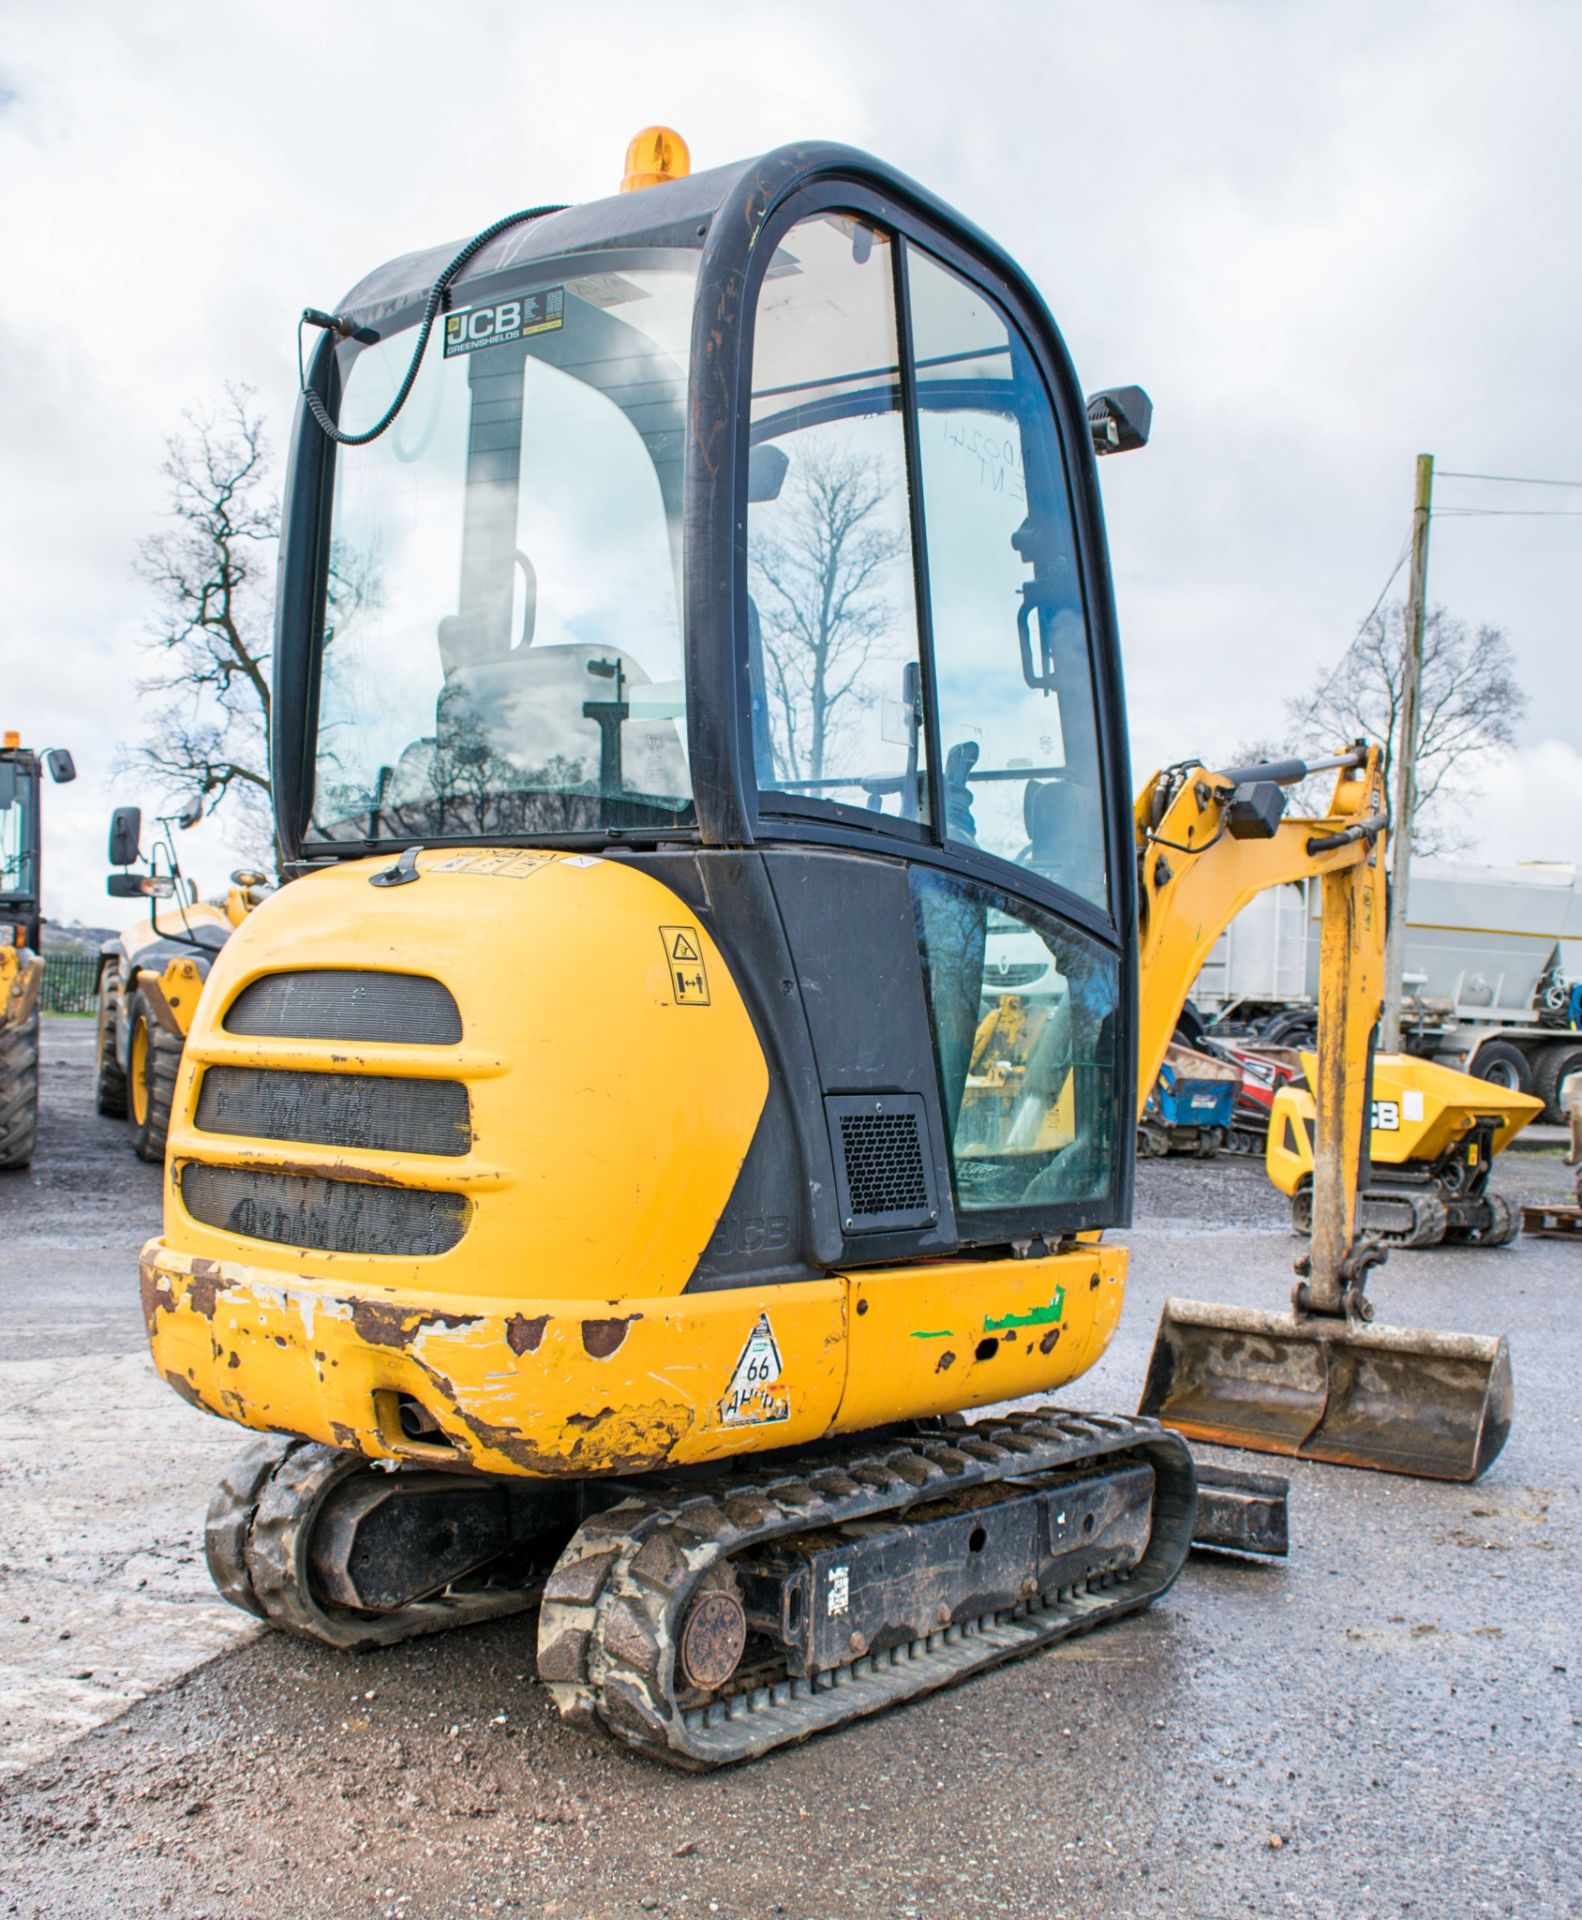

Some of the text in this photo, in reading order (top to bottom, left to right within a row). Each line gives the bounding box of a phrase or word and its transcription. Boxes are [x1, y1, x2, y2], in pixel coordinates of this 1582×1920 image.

[448, 302, 521, 345] JCB
[447, 329, 520, 355] GREENSHIELDS
[747, 1356, 769, 1381] 66
